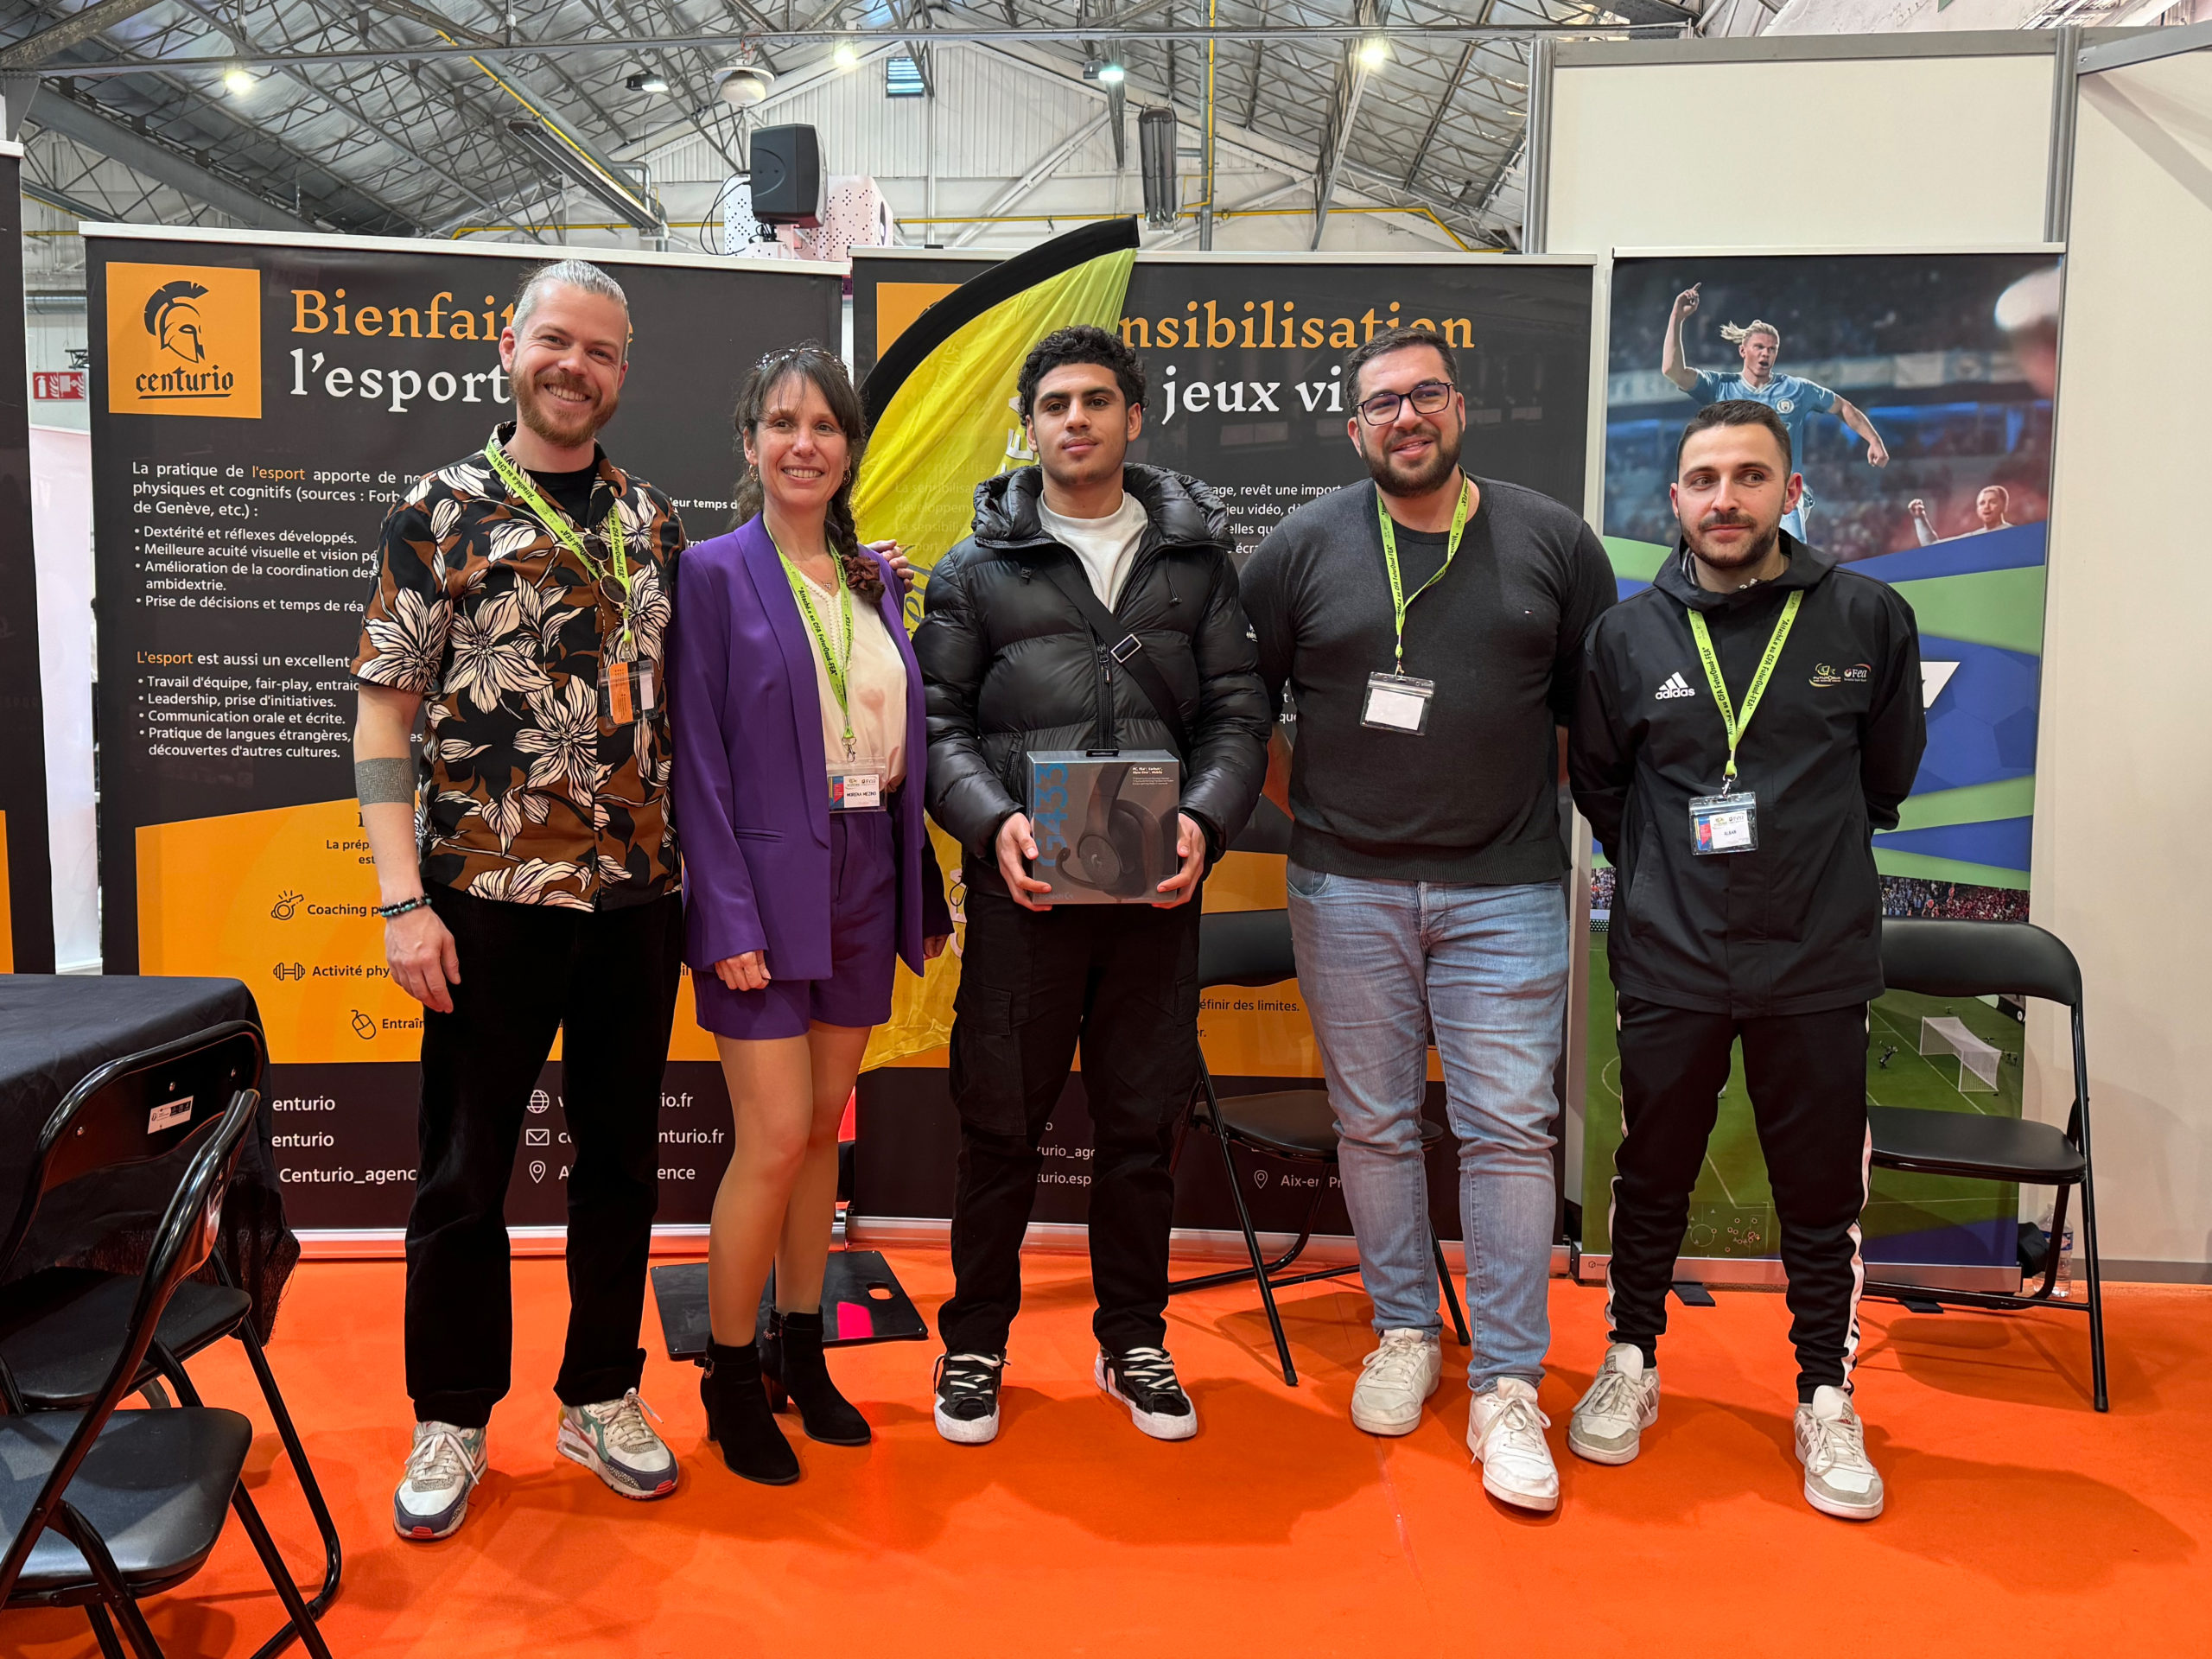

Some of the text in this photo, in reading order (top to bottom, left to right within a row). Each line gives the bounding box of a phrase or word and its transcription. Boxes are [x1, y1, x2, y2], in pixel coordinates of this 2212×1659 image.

[135, 364, 234, 393] centurio
[290, 348, 510, 413] l'esport
[1162, 365, 1281, 426] jeux
[133, 462, 148, 474] La
[157, 463, 217, 479] pratique
[226, 465, 244, 477] de
[253, 466, 305, 481] l'esport
[314, 471, 370, 484] apporte
[378, 471, 396, 483] de
[134, 481, 205, 498] physiques
[210, 485, 224, 496] et
[230, 486, 291, 499] cognitifs
[296, 486, 355, 502] (sources
[1241, 484, 1271, 495] revêt
[134, 500, 151, 512] de
[156, 501, 214, 517] Genève,
[219, 504, 249, 519] etc.)
[694, 499, 728, 511] temps
[1226, 505, 1243, 516] jeu
[1248, 504, 1283, 516] vidéo,
[144, 526, 356, 545] Dextérité et réflexes développés.
[145, 543, 204, 556] Meilleure
[208, 545, 247, 556] acuité
[251, 546, 299, 558] visuelle
[304, 550, 316, 559] et
[321, 549, 358, 560] vision
[145, 561, 227, 573] Amélioration
[232, 563, 248, 574] de
[252, 563, 262, 575] la
[266, 564, 348, 578] coordination
[146, 578, 226, 590] ambidextrie.
[146, 595, 175, 607] Prise
[180, 596, 195, 607] de
[200, 596, 259, 608] décisions
[264, 600, 276, 609] et
[280, 600, 320, 613] temps
[324, 600, 340, 611] de
[137, 652, 349, 667] L'esport est aussi un excellent
[1764, 653, 1775, 665] CFA
[148, 676, 188, 687] Travail
[193, 677, 251, 690] d'équipe,
[256, 677, 312, 692] fair-play,
[149, 693, 336, 708] Leadership, prise d'initiatives.
[1655, 686, 1696, 700] adidas
[149, 710, 345, 724] Communication orale et écrite.
[149, 728, 351, 743] Pratique de langues étrangères,
[149, 744, 340, 757] découvertes d'autres cultures.
[1034, 763, 1068, 867] G433
[326, 839, 340, 849] La
[307, 904, 367, 917] Coaching
[312, 964, 362, 976] Activité
[1233, 1000, 1255, 1010] des
[1257, 1000, 1300, 1012] limites.
[660, 1093, 693, 1108] io.fr
